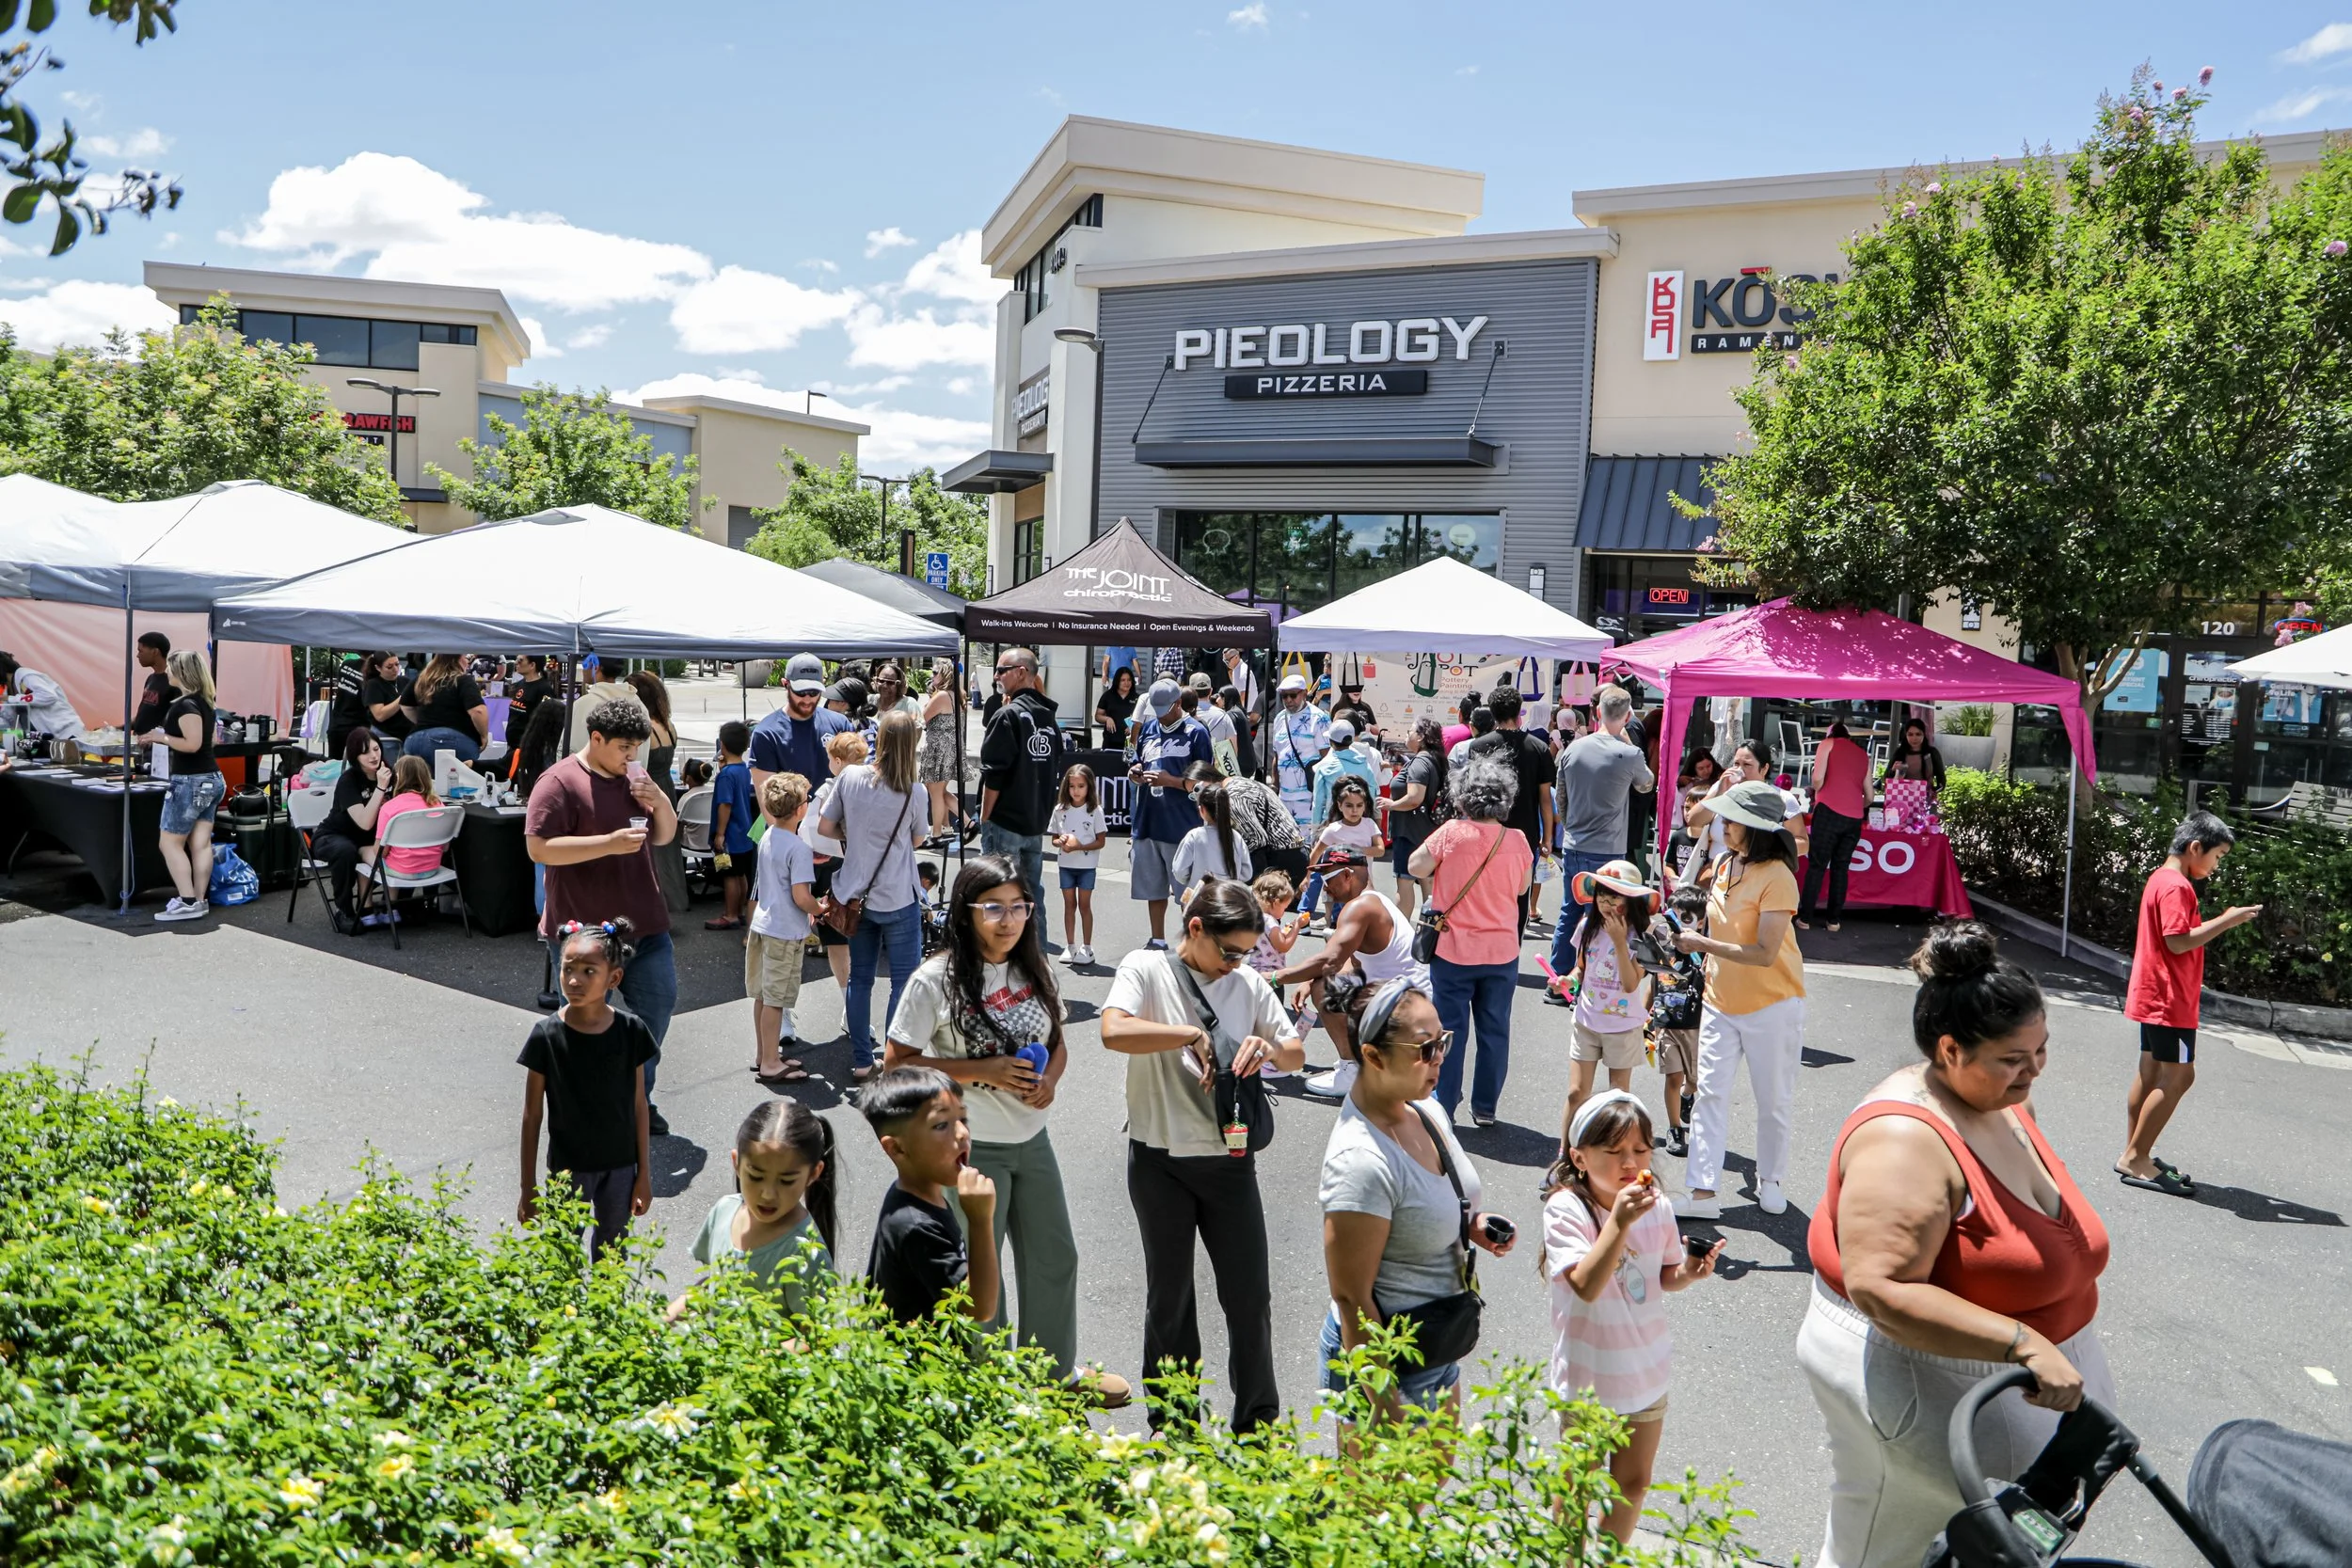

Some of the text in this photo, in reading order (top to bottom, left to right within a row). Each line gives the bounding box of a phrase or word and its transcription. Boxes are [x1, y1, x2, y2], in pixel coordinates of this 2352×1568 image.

[1175, 316, 1488, 371] PIEOLOGY
[1697, 335, 1794, 349] RAMEN
[1257, 374, 1387, 394] PIZZERIA
[1010, 375, 1050, 425] PIEOLOG
[1065, 567, 1097, 579] THE
[1063, 589, 1172, 603] chiropractic
[1651, 589, 1687, 602] OPEN
[981, 619, 1012, 627] Walk-ins
[1072, 622, 1108, 630] Insurance
[1150, 624, 1170, 632] Open
[1172, 624, 1206, 633] Evenings
[2201, 621, 2235, 635] 120
[2188, 674, 2237, 684] chiropractic
